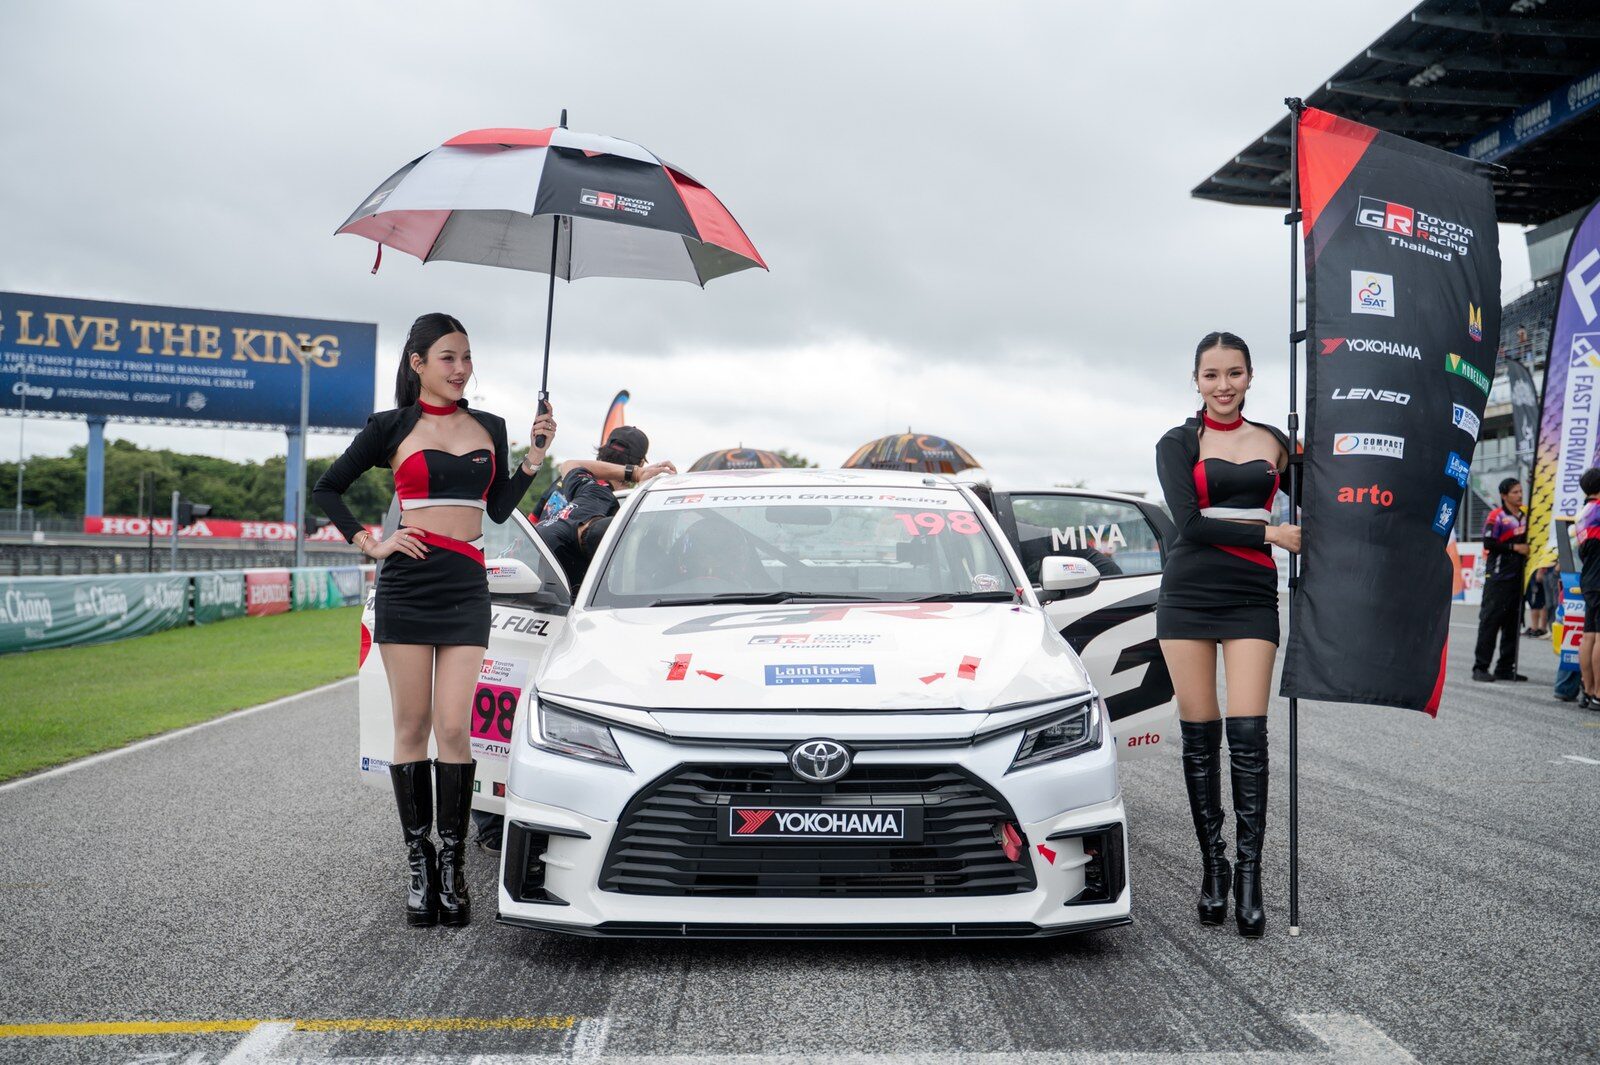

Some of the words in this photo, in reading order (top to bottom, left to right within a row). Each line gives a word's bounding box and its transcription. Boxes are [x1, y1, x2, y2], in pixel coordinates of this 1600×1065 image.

[581, 194, 613, 208] GR
[616, 204, 648, 216] Racing
[617, 195, 655, 207] TOYOTA
[617, 200, 651, 211] GAZOO
[1358, 208, 1411, 235] GR
[1416, 211, 1474, 237] TOYOTA
[1416, 222, 1469, 244] GAZOO
[1416, 231, 1468, 256] Racing
[1388, 236, 1452, 261] Thailand
[1361, 298, 1387, 307] SAT
[16, 310, 121, 352] LIVE
[130, 319, 222, 359] THE
[232, 328, 342, 368] KING
[1346, 338, 1422, 360] YOKOHAMA
[1331, 387, 1411, 405] LENSO
[1571, 374, 1594, 413] FAST
[1363, 437, 1403, 449] COMPACT
[1562, 417, 1589, 493] FORWARD
[709, 494, 792, 502] TOYOTA
[798, 493, 873, 501] GAZOO
[878, 494, 947, 505] Racing
[1337, 484, 1394, 508] arto
[894, 511, 982, 536] 198
[1051, 523, 1128, 552] MIYA
[6, 589, 53, 628] Chang
[502, 615, 550, 637] FUEL
[775, 666, 840, 676] Lamina
[470, 687, 516, 740] 98
[485, 744, 511, 755] ATIV
[1127, 732, 1161, 748] arto
[775, 812, 899, 834] YOKOHAMA
